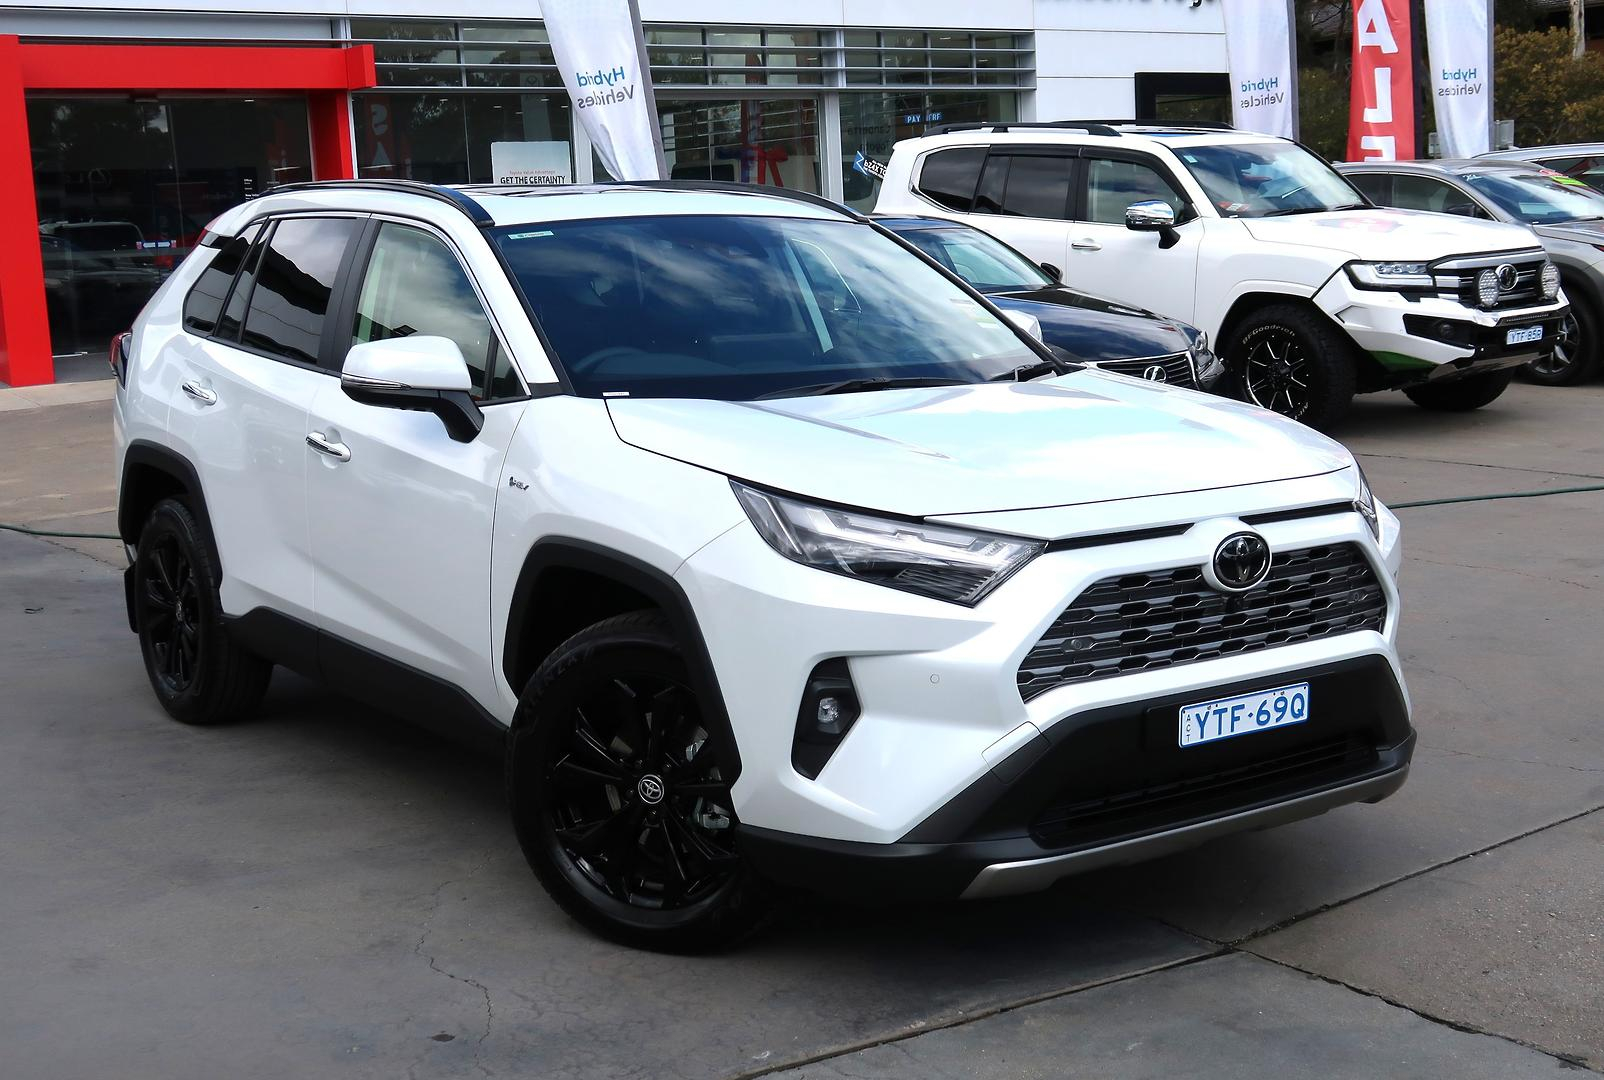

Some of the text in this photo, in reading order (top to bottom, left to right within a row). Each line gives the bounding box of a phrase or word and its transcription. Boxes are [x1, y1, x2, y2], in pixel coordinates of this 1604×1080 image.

[907, 115, 921, 124] PAY
[500, 175, 566, 184] GET THE CERTAINTY
